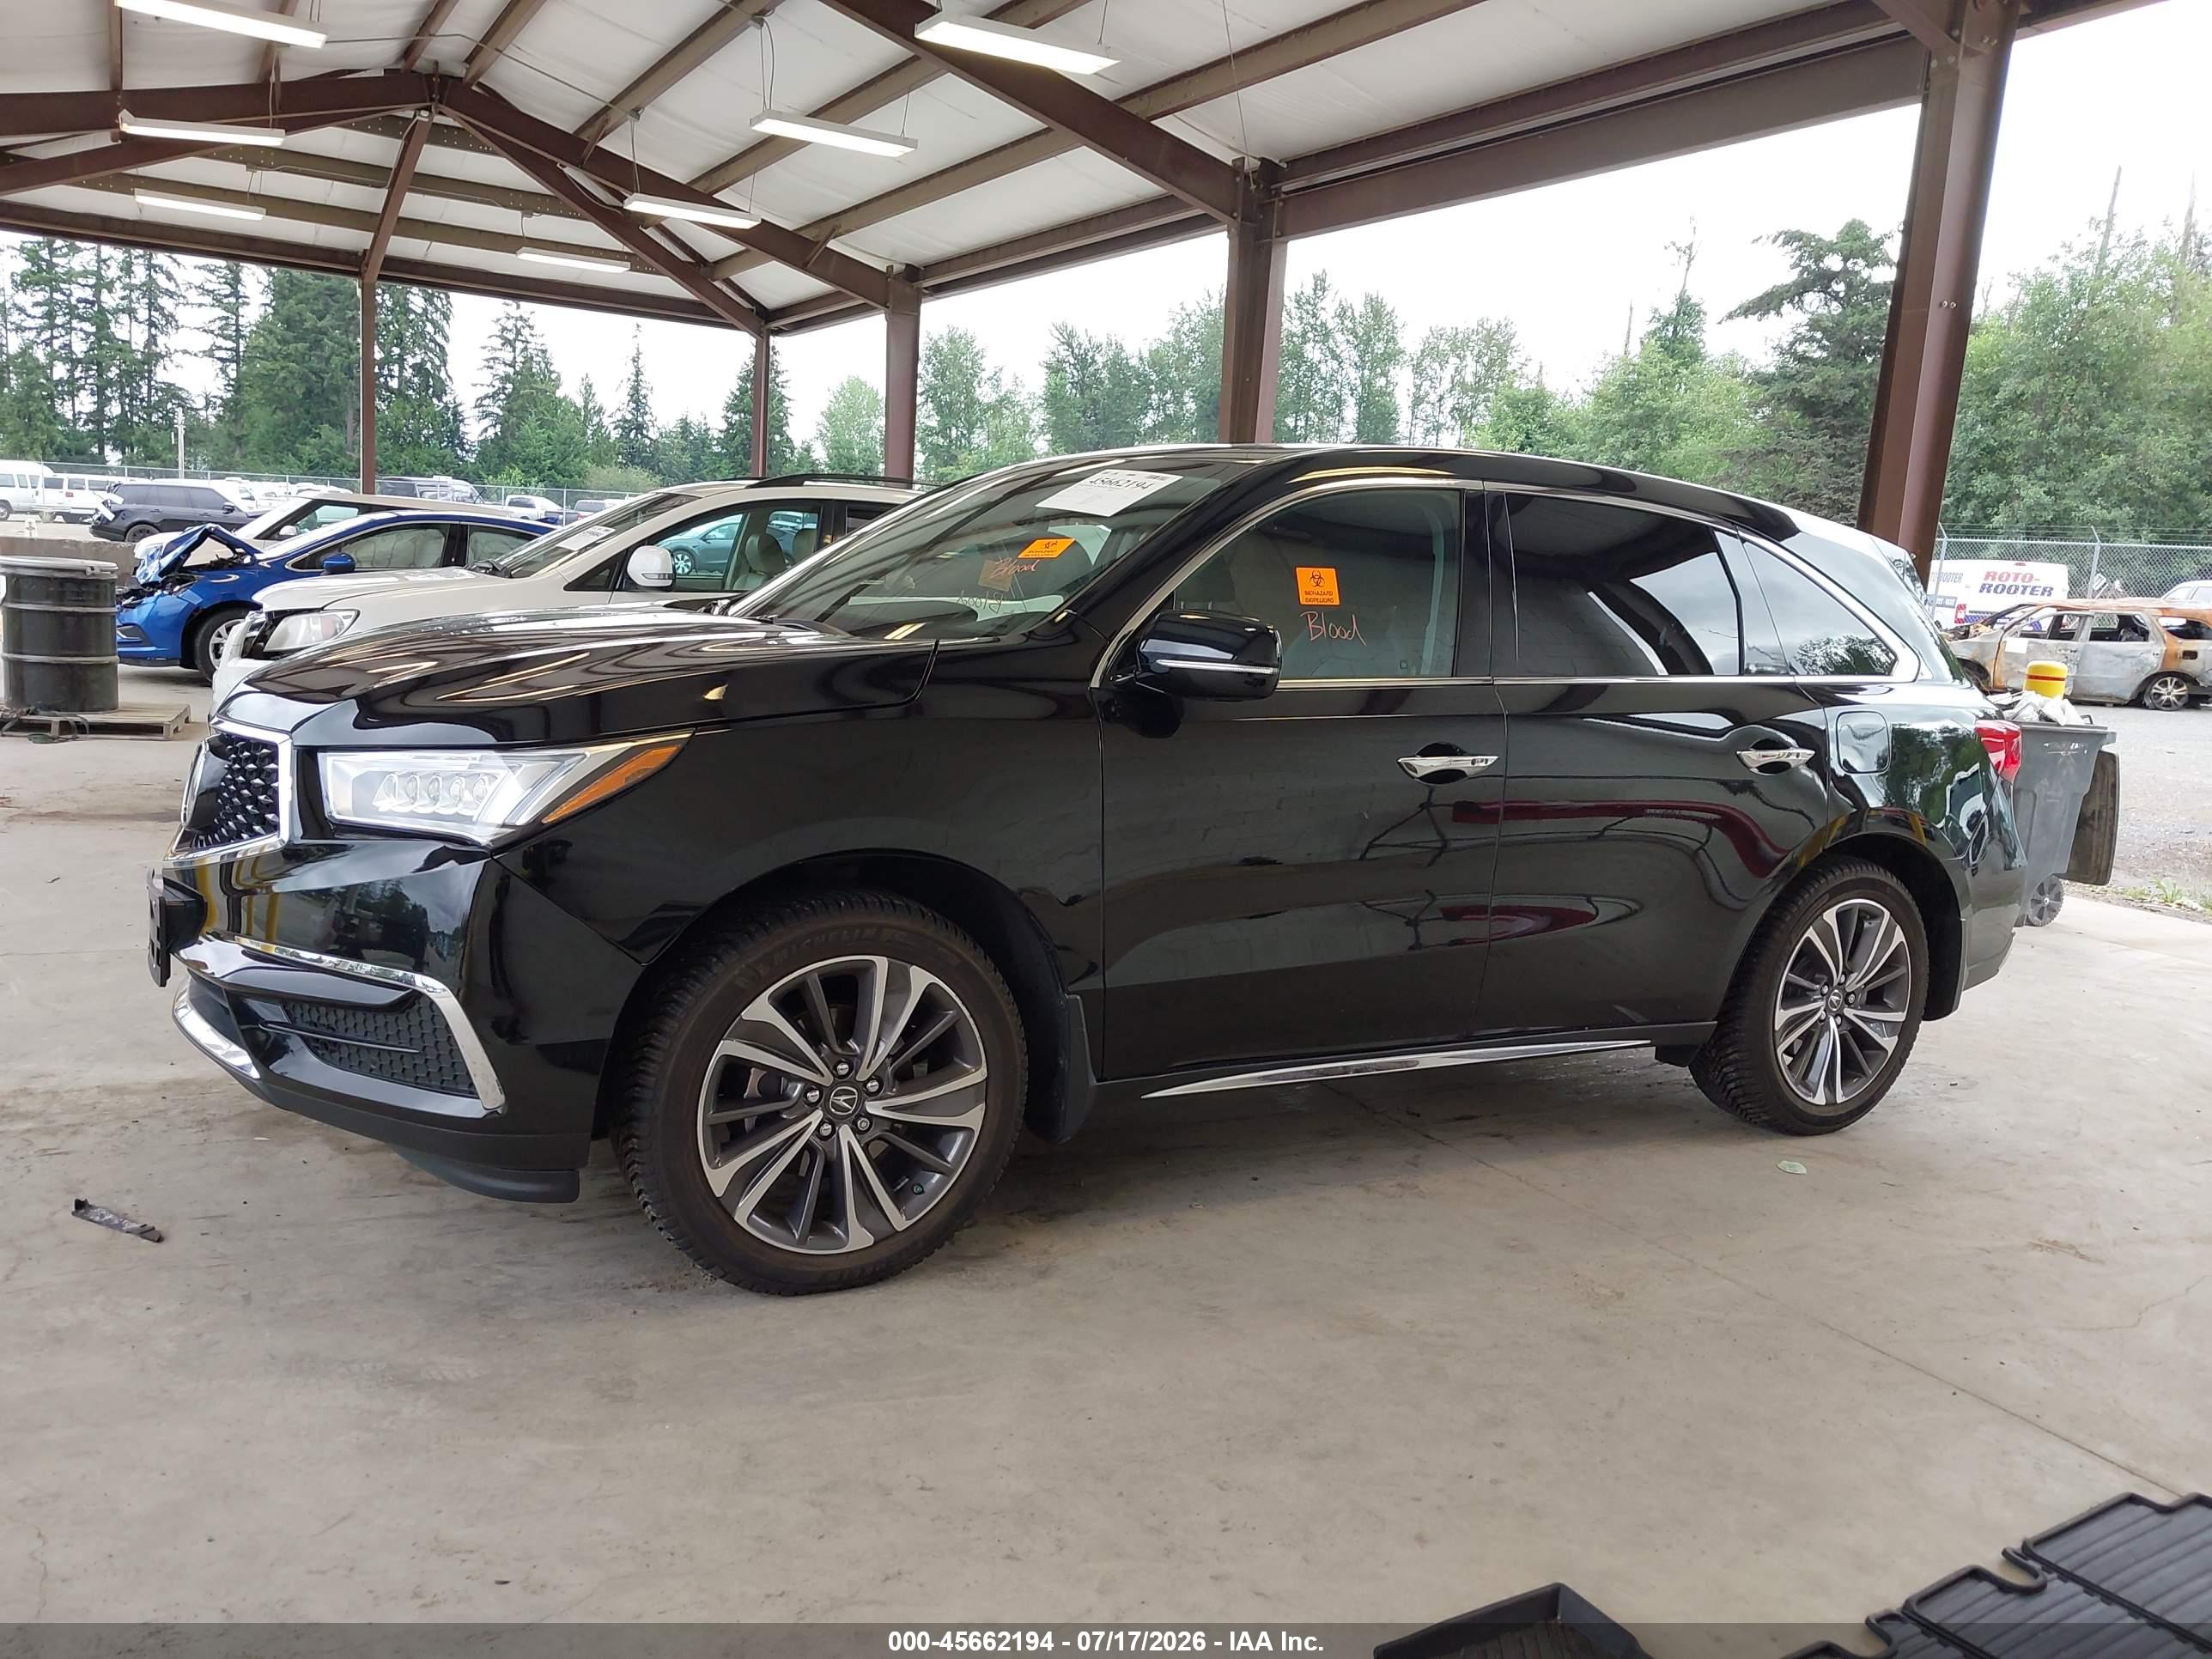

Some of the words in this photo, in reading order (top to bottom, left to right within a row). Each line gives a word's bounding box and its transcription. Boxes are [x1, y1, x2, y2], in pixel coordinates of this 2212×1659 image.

[1984, 570, 2040, 584] ROTO-
[1978, 583, 2054, 597] ROOTER
[1299, 611, 1367, 647] Blood
